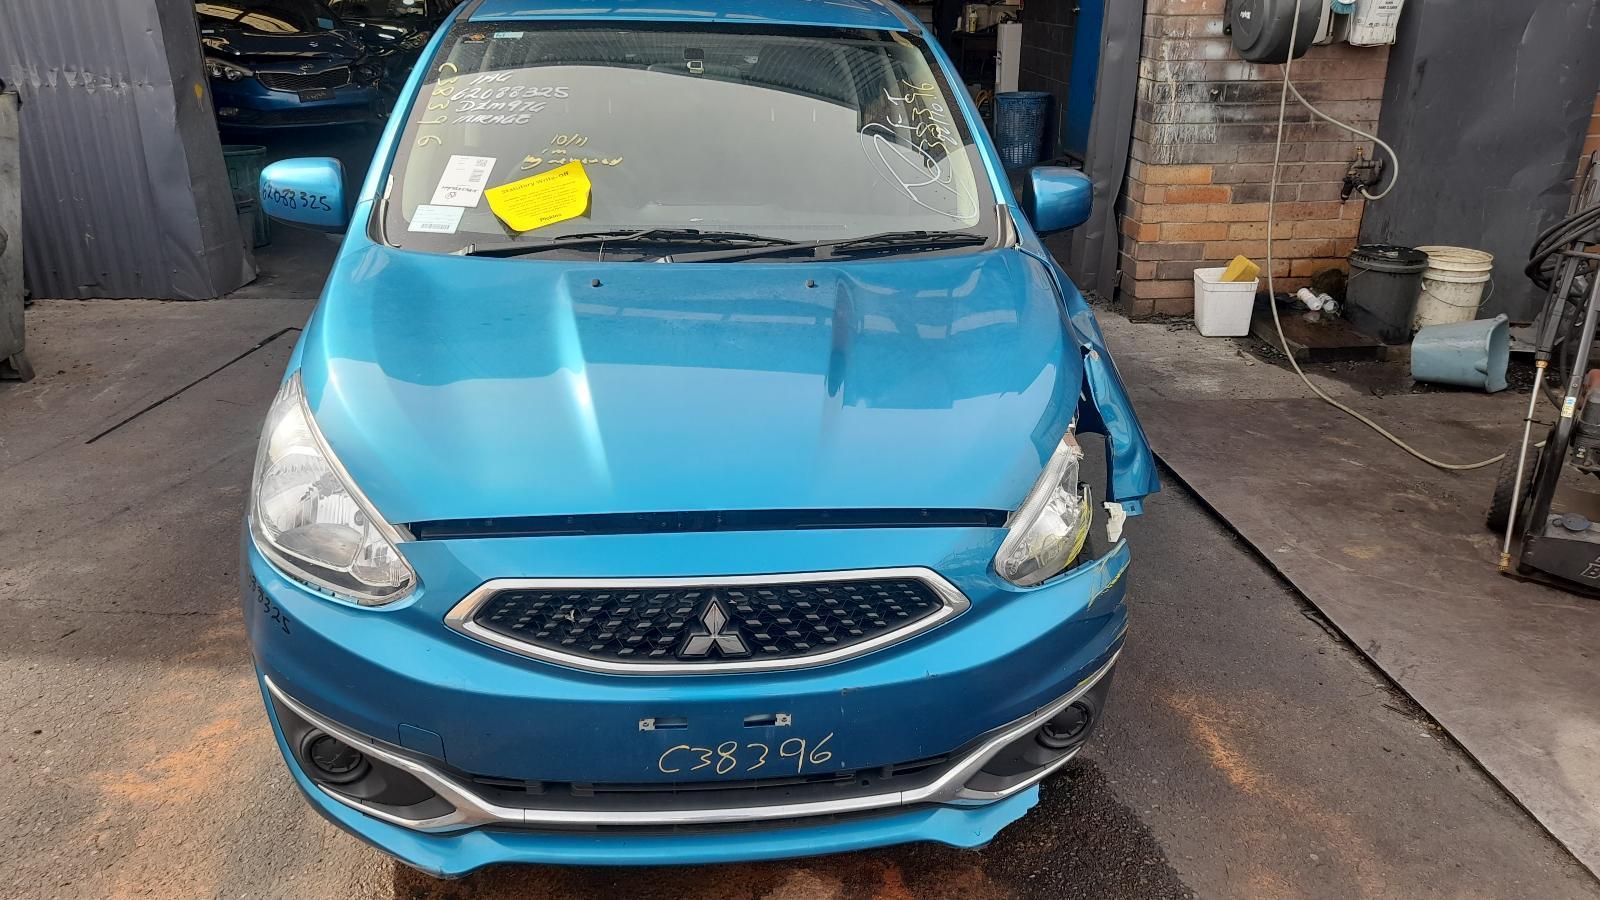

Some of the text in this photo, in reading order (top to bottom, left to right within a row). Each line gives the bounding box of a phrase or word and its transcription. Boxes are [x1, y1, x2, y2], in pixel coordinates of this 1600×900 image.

[416, 61, 458, 148] C38396
[450, 86, 569, 101] 62088325
[263, 182, 332, 211] 62088325
[658, 732, 834, 775] C38396
